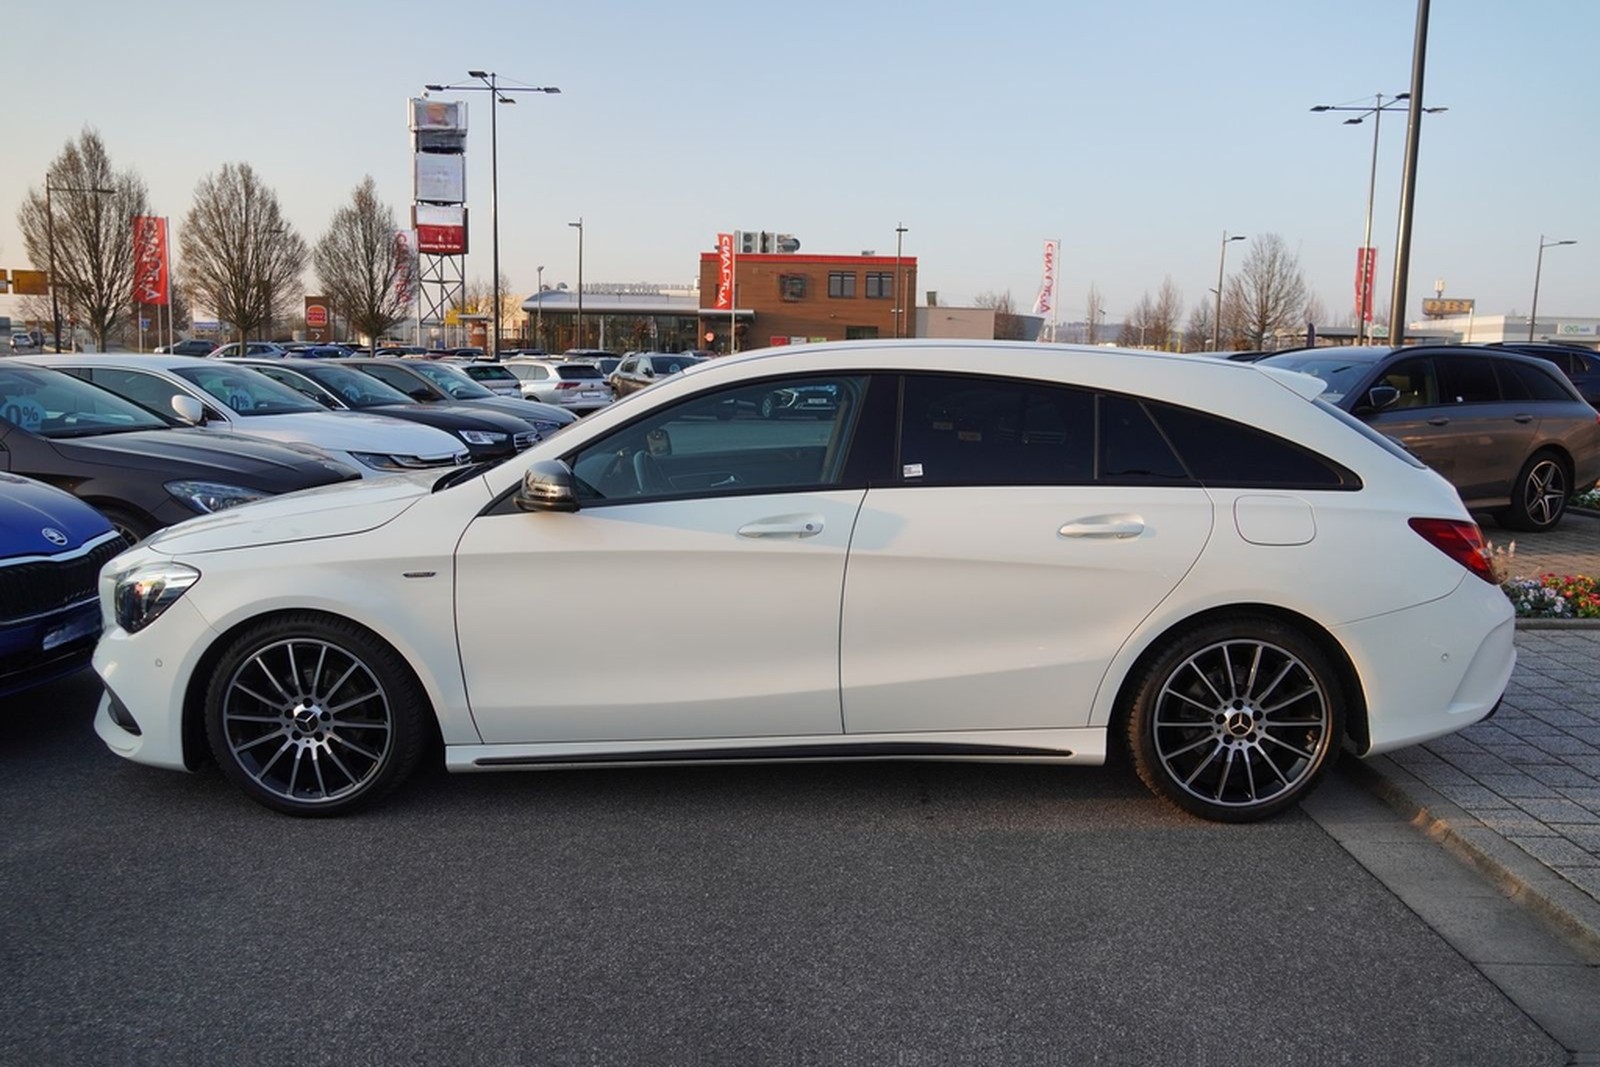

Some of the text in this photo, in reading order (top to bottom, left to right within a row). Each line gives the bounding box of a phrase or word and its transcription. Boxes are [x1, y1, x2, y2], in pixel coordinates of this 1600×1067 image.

[1425, 300, 1471, 312] OBI
[230, 395, 249, 410] 0%
[6, 404, 39, 426] 0%
